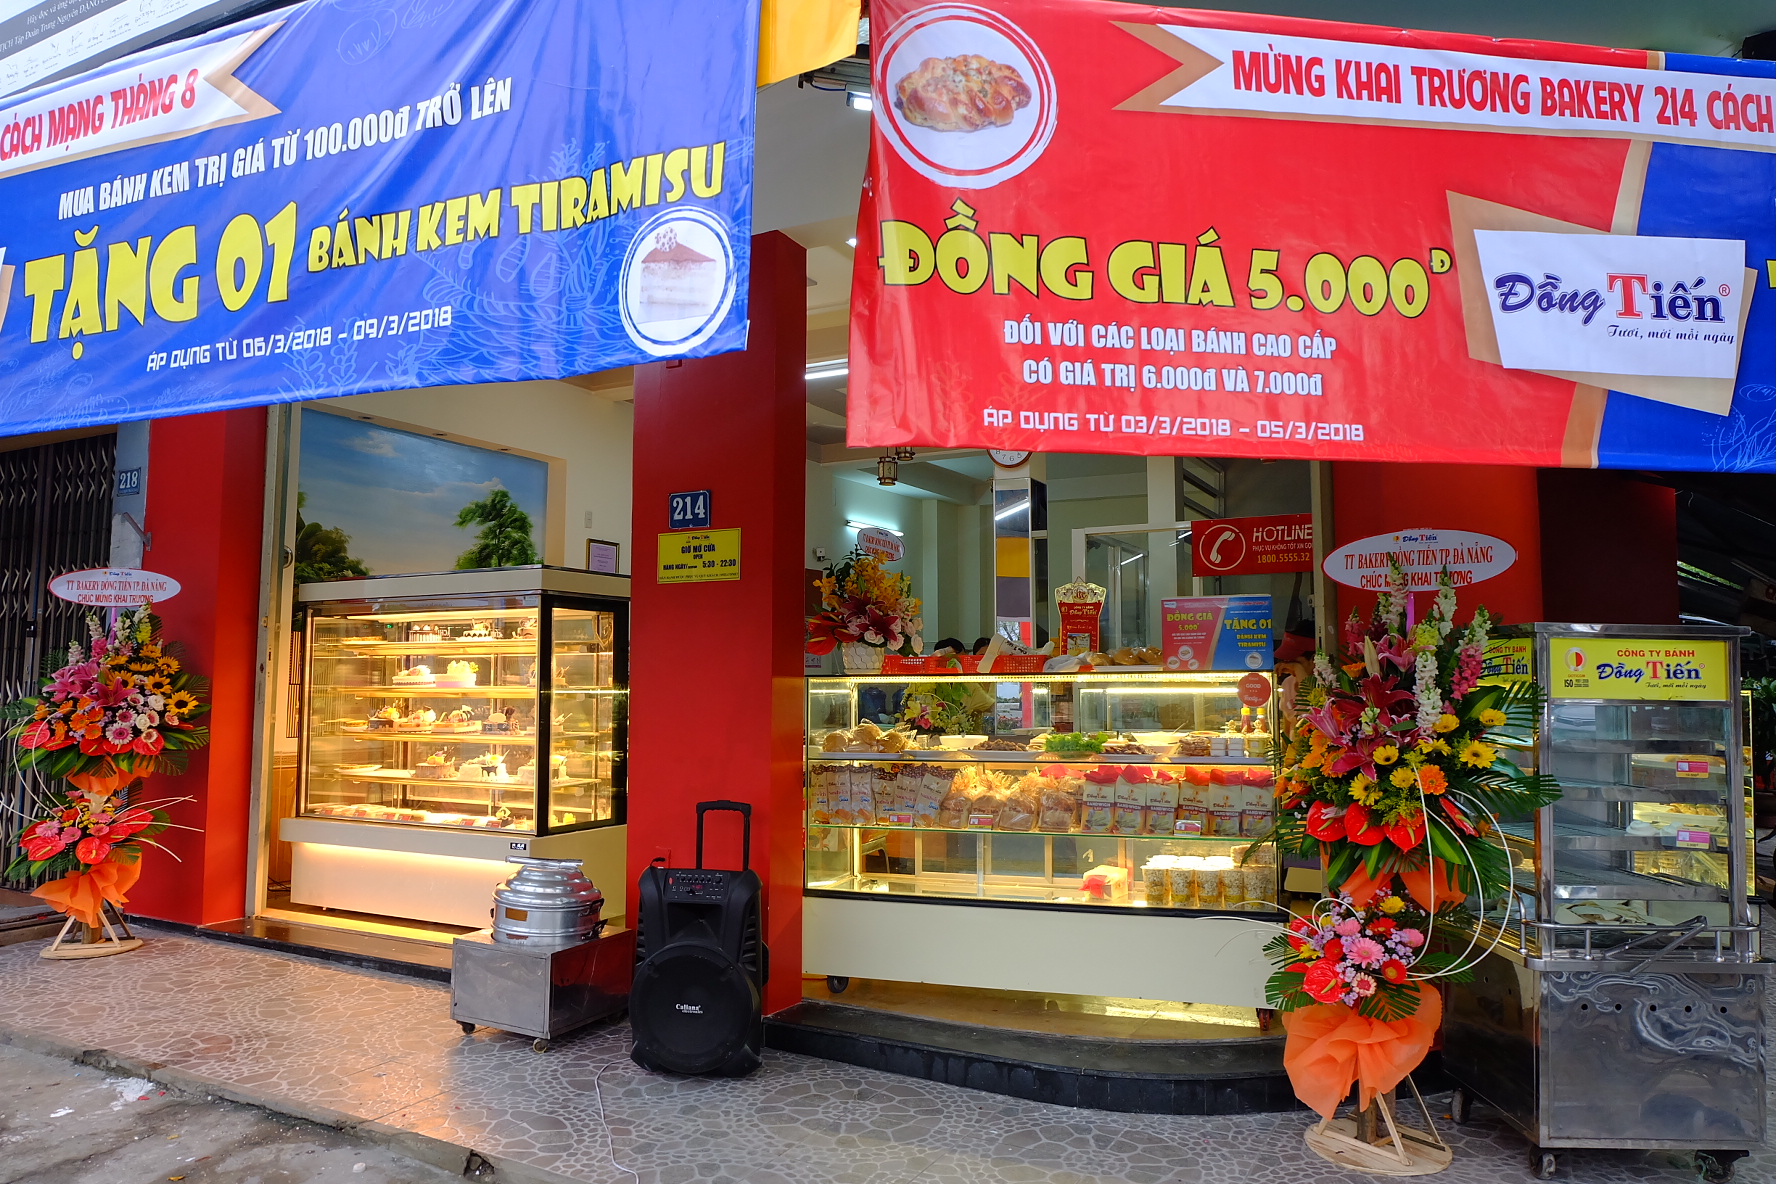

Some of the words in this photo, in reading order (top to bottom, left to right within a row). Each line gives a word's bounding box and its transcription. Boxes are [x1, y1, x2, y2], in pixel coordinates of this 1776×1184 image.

[1232, 43, 1326, 98] MỪNG
[1334, 58, 1402, 105] KHAI
[1410, 65, 1531, 115] TRƯƠNG
[1538, 76, 1645, 123] BAKERY
[1654, 85, 1698, 128] 214
[1706, 83, 1774, 133] CÁCH
[1, 112, 43, 161] CÁCH
[47, 95, 104, 152] MẠNG
[110, 72, 178, 130] THÁNG
[181, 68, 199, 109] 8
[58, 186, 94, 220] MUA
[99, 175, 147, 209] BÁNH
[149, 162, 190, 198] KEM
[194, 153, 226, 188] TRỊ
[231, 142, 264, 176] GIÁ
[271, 129, 298, 166] TỪ
[414, 82, 462, 131] TRỞ
[470, 77, 513, 121] LÊN
[23, 225, 200, 360] TẶNG
[215, 201, 297, 312] 01
[307, 206, 413, 273] BÁNH
[414, 187, 502, 252] KEM
[510, 141, 727, 235] TIRAMISU
[877, 197, 1094, 298] ĐỒNG
[1107, 226, 1234, 308] GIÁ
[1494, 272, 1606, 326] Đồng
[146, 350, 166, 372] ÁP
[169, 343, 210, 370] DỤNG
[215, 337, 238, 361] TỪ
[242, 325, 332, 359] 06/3/2018
[352, 305, 453, 342] 09/3/2018
[1004, 313, 1042, 346] ĐỐI
[1047, 318, 1084, 348] VỚI
[1090, 318, 1135, 351] CÁC
[1140, 326, 1186, 356] LOẠI
[1191, 325, 1247, 356] BÁNH
[1250, 332, 1291, 359] CAO
[1297, 327, 1338, 361] CẤP
[1647, 327, 1673, 341] mới
[1675, 327, 1700, 342] mỗi
[1703, 331, 1736, 345] ngày
[1022, 354, 1053, 385] CÓ
[1058, 358, 1097, 388] GIÁ
[1101, 363, 1137, 393] TRỊ
[1142, 366, 1217, 393] 6.000đ
[1222, 366, 1249, 395] VÀ
[1255, 371, 1323, 397] 7.000đ
[983, 407, 1012, 428] ÁP
[1019, 411, 1078, 434] DỤNG
[1086, 409, 1114, 433] TỪ
[1121, 414, 1232, 437] 03/3/2018
[1256, 421, 1364, 442] 05/3/2018
[119, 471, 138, 489] 218
[672, 495, 705, 520] 214
[1253, 524, 1312, 542] HOTLINE
[702, 560, 715, 568] 5:30
[720, 559, 736, 568] 22:30
[1257, 552, 1310, 563] 1800.5555.32
[1345, 554, 1356, 570] TT
[1358, 552, 1391, 569] BAKERY
[1439, 548, 1451, 565] TP.
[1453, 542, 1465, 564] ĐÀ
[1360, 570, 1382, 588] CHÚC
[1411, 572, 1432, 586] KHAI
[1224, 617, 1257, 632] TẶNG
[1260, 618, 1272, 629] 01
[1617, 648, 1645, 657] CÔNG
[1648, 650, 1662, 658] TY
[1664, 648, 1695, 658] BÁNH
[1564, 679, 1574, 688] ISO
[1596, 662, 1644, 683] Đồng
[1646, 660, 1702, 680] Tiến
